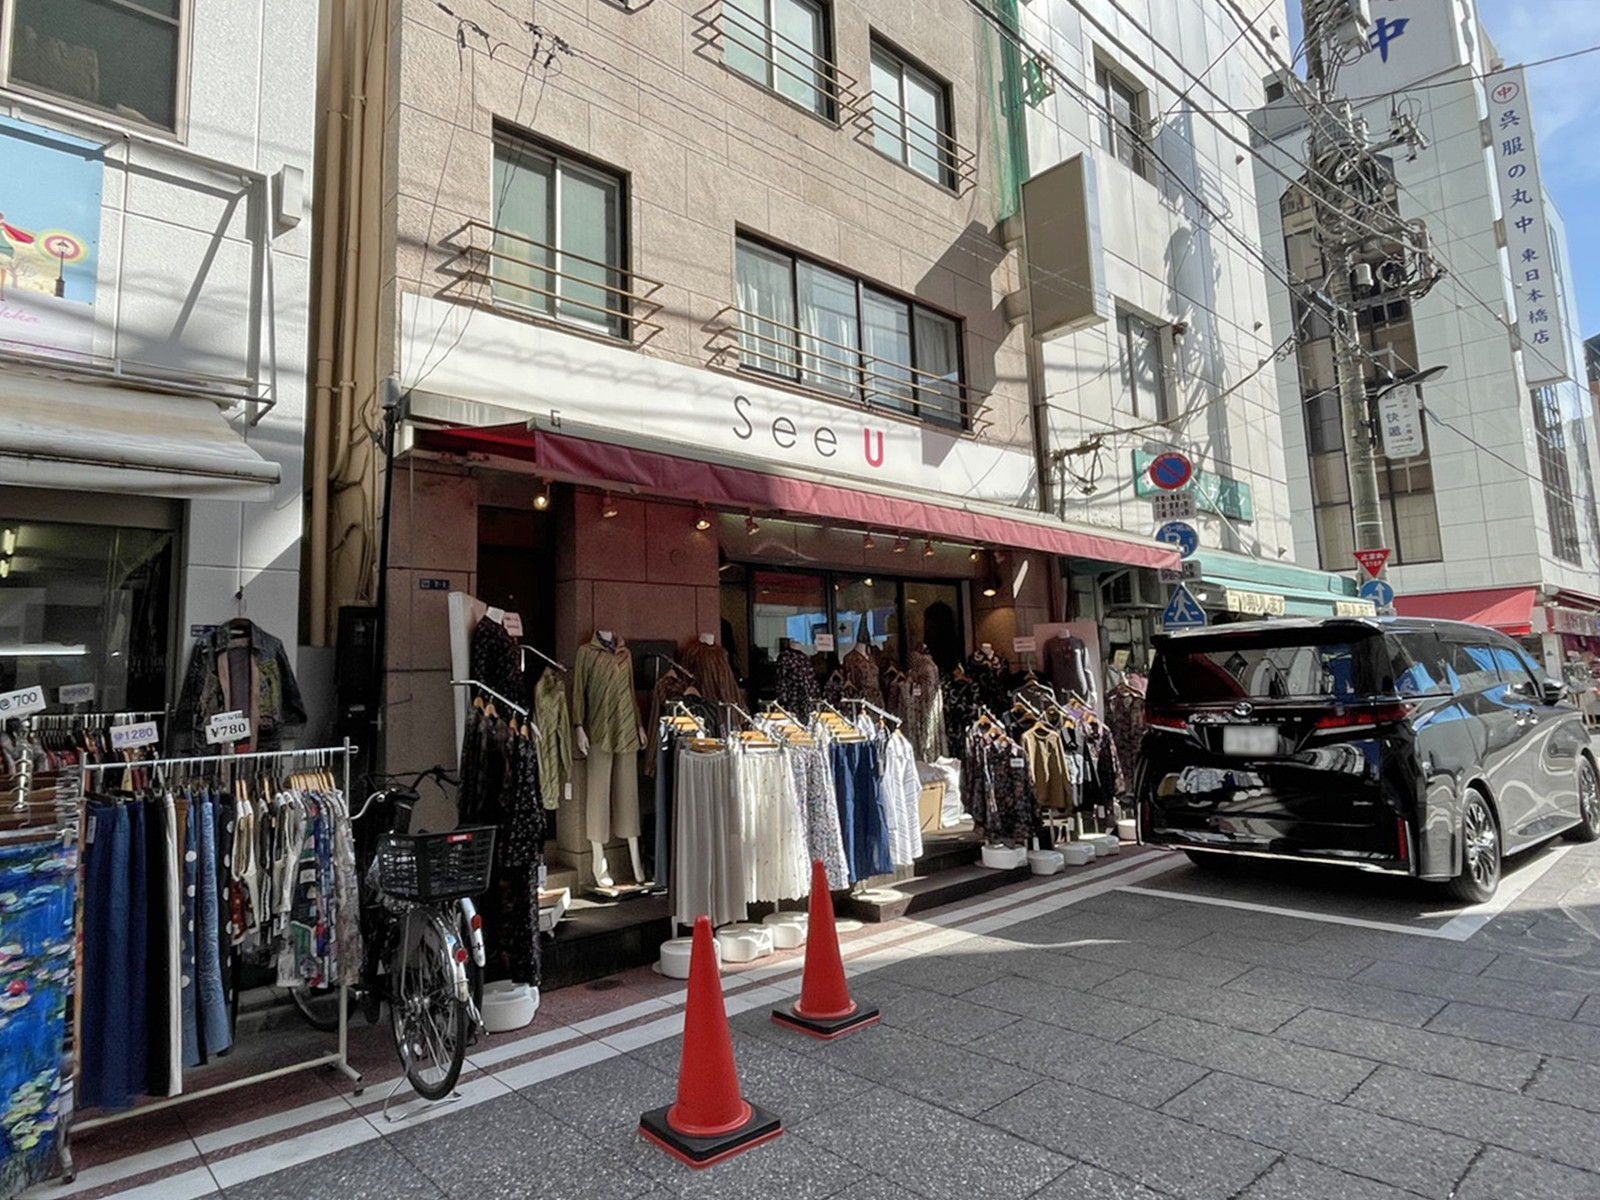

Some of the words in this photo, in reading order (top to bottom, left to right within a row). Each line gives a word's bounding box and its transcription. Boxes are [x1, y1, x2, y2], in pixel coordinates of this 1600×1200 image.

[1368, 17, 1410, 64] 中
[1499, 109, 1535, 234] 呉服の丸中
[1521, 248, 1550, 345] 東日本橋店
[732, 395, 838, 458] See
[864, 428, 884, 468] U
[114, 727, 153, 740] @1280
